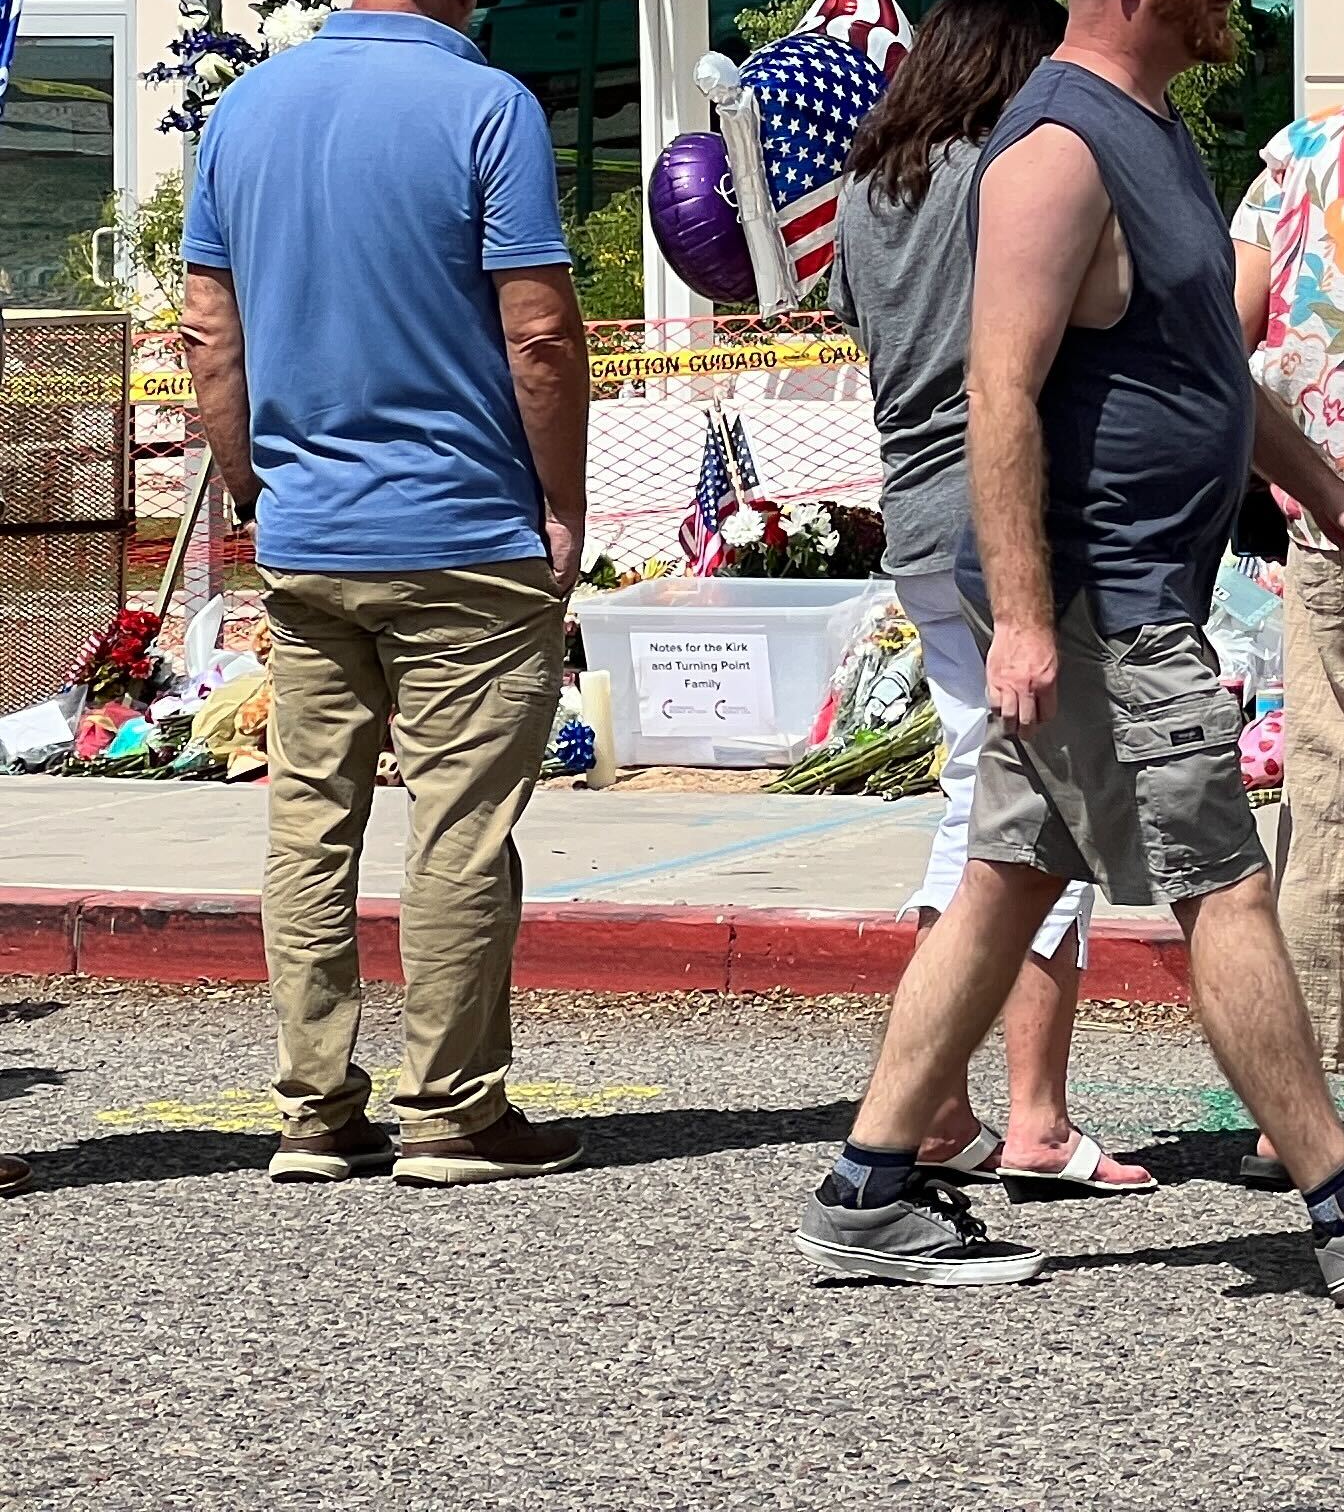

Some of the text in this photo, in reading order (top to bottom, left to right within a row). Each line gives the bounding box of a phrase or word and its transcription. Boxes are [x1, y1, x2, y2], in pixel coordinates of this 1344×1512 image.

[819, 346, 868, 364] CAU
[590, 349, 778, 379] CAUTION CUIDADO
[649, 642, 748, 652] Notes for the Kirk
[651, 660, 751, 673] and Turning Point
[684, 679, 721, 691] Family
